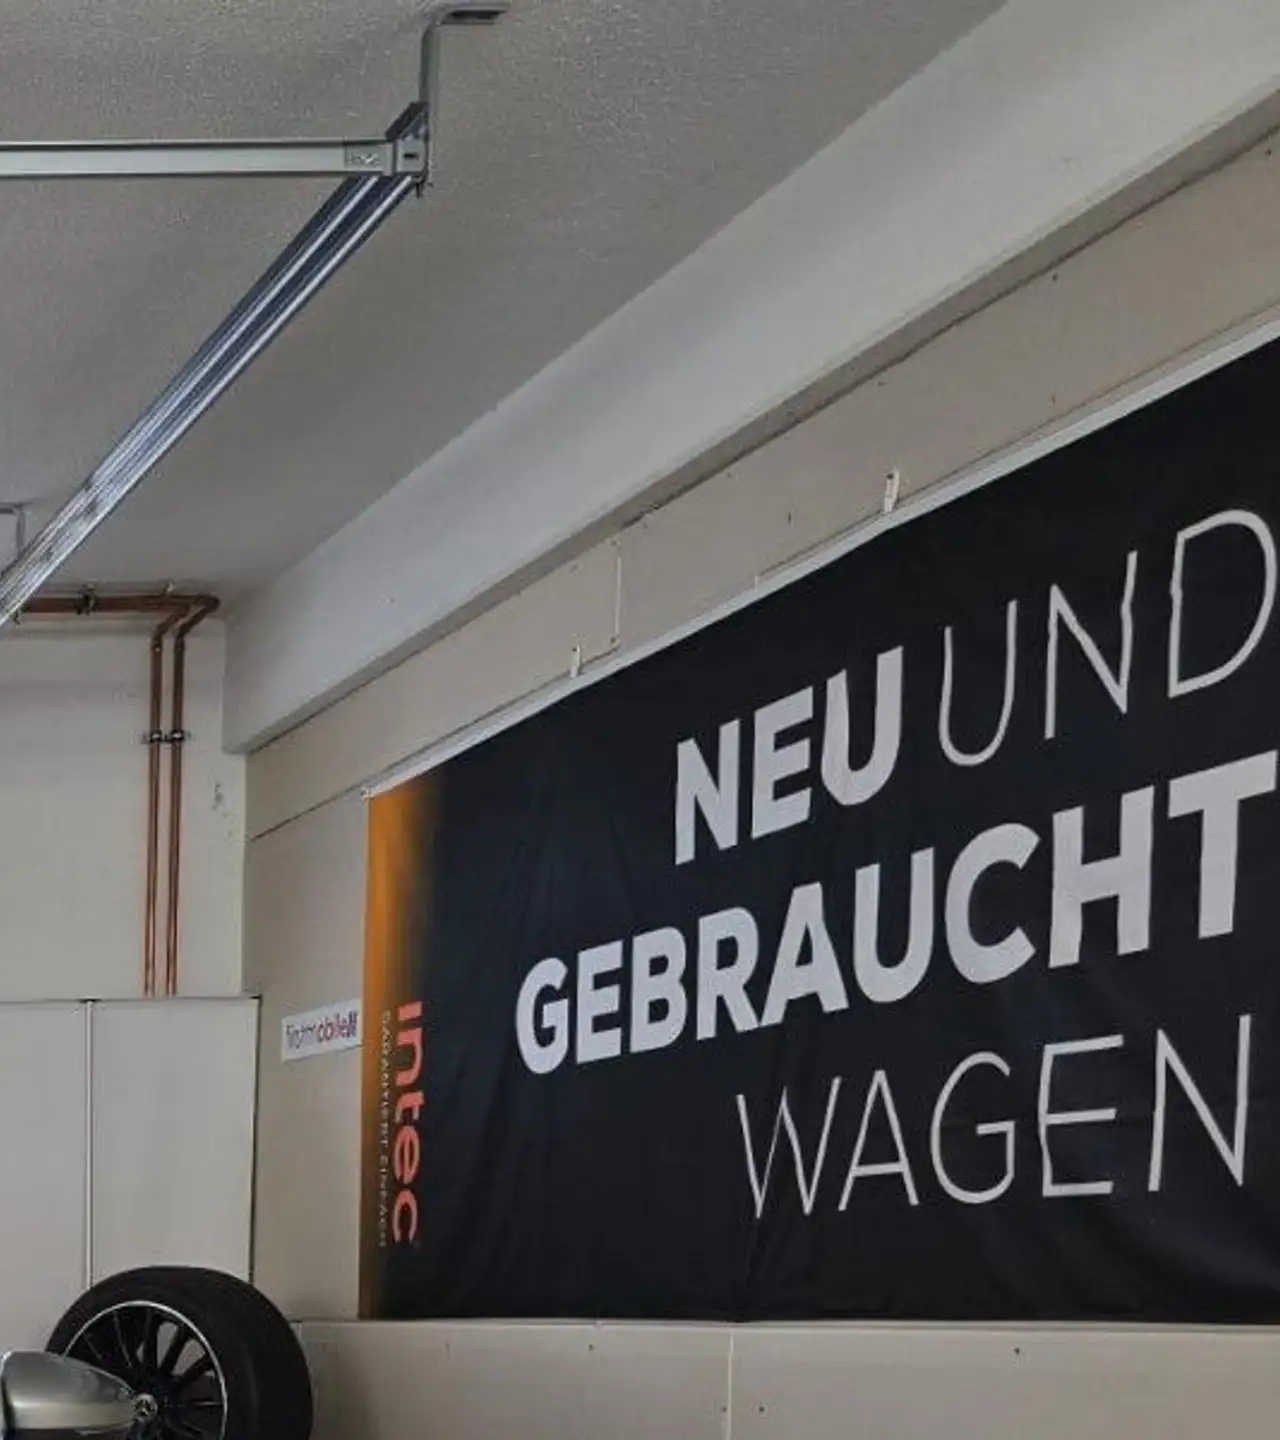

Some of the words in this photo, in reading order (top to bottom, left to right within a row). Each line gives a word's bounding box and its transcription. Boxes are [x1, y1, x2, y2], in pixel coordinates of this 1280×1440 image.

[675, 646, 903, 865] NEU
[938, 508, 1278, 767] UND
[515, 750, 1278, 1075] GEBRAUCHT
[392, 1000, 425, 1244] intec
[735, 1014, 1252, 1219] WAGEN
